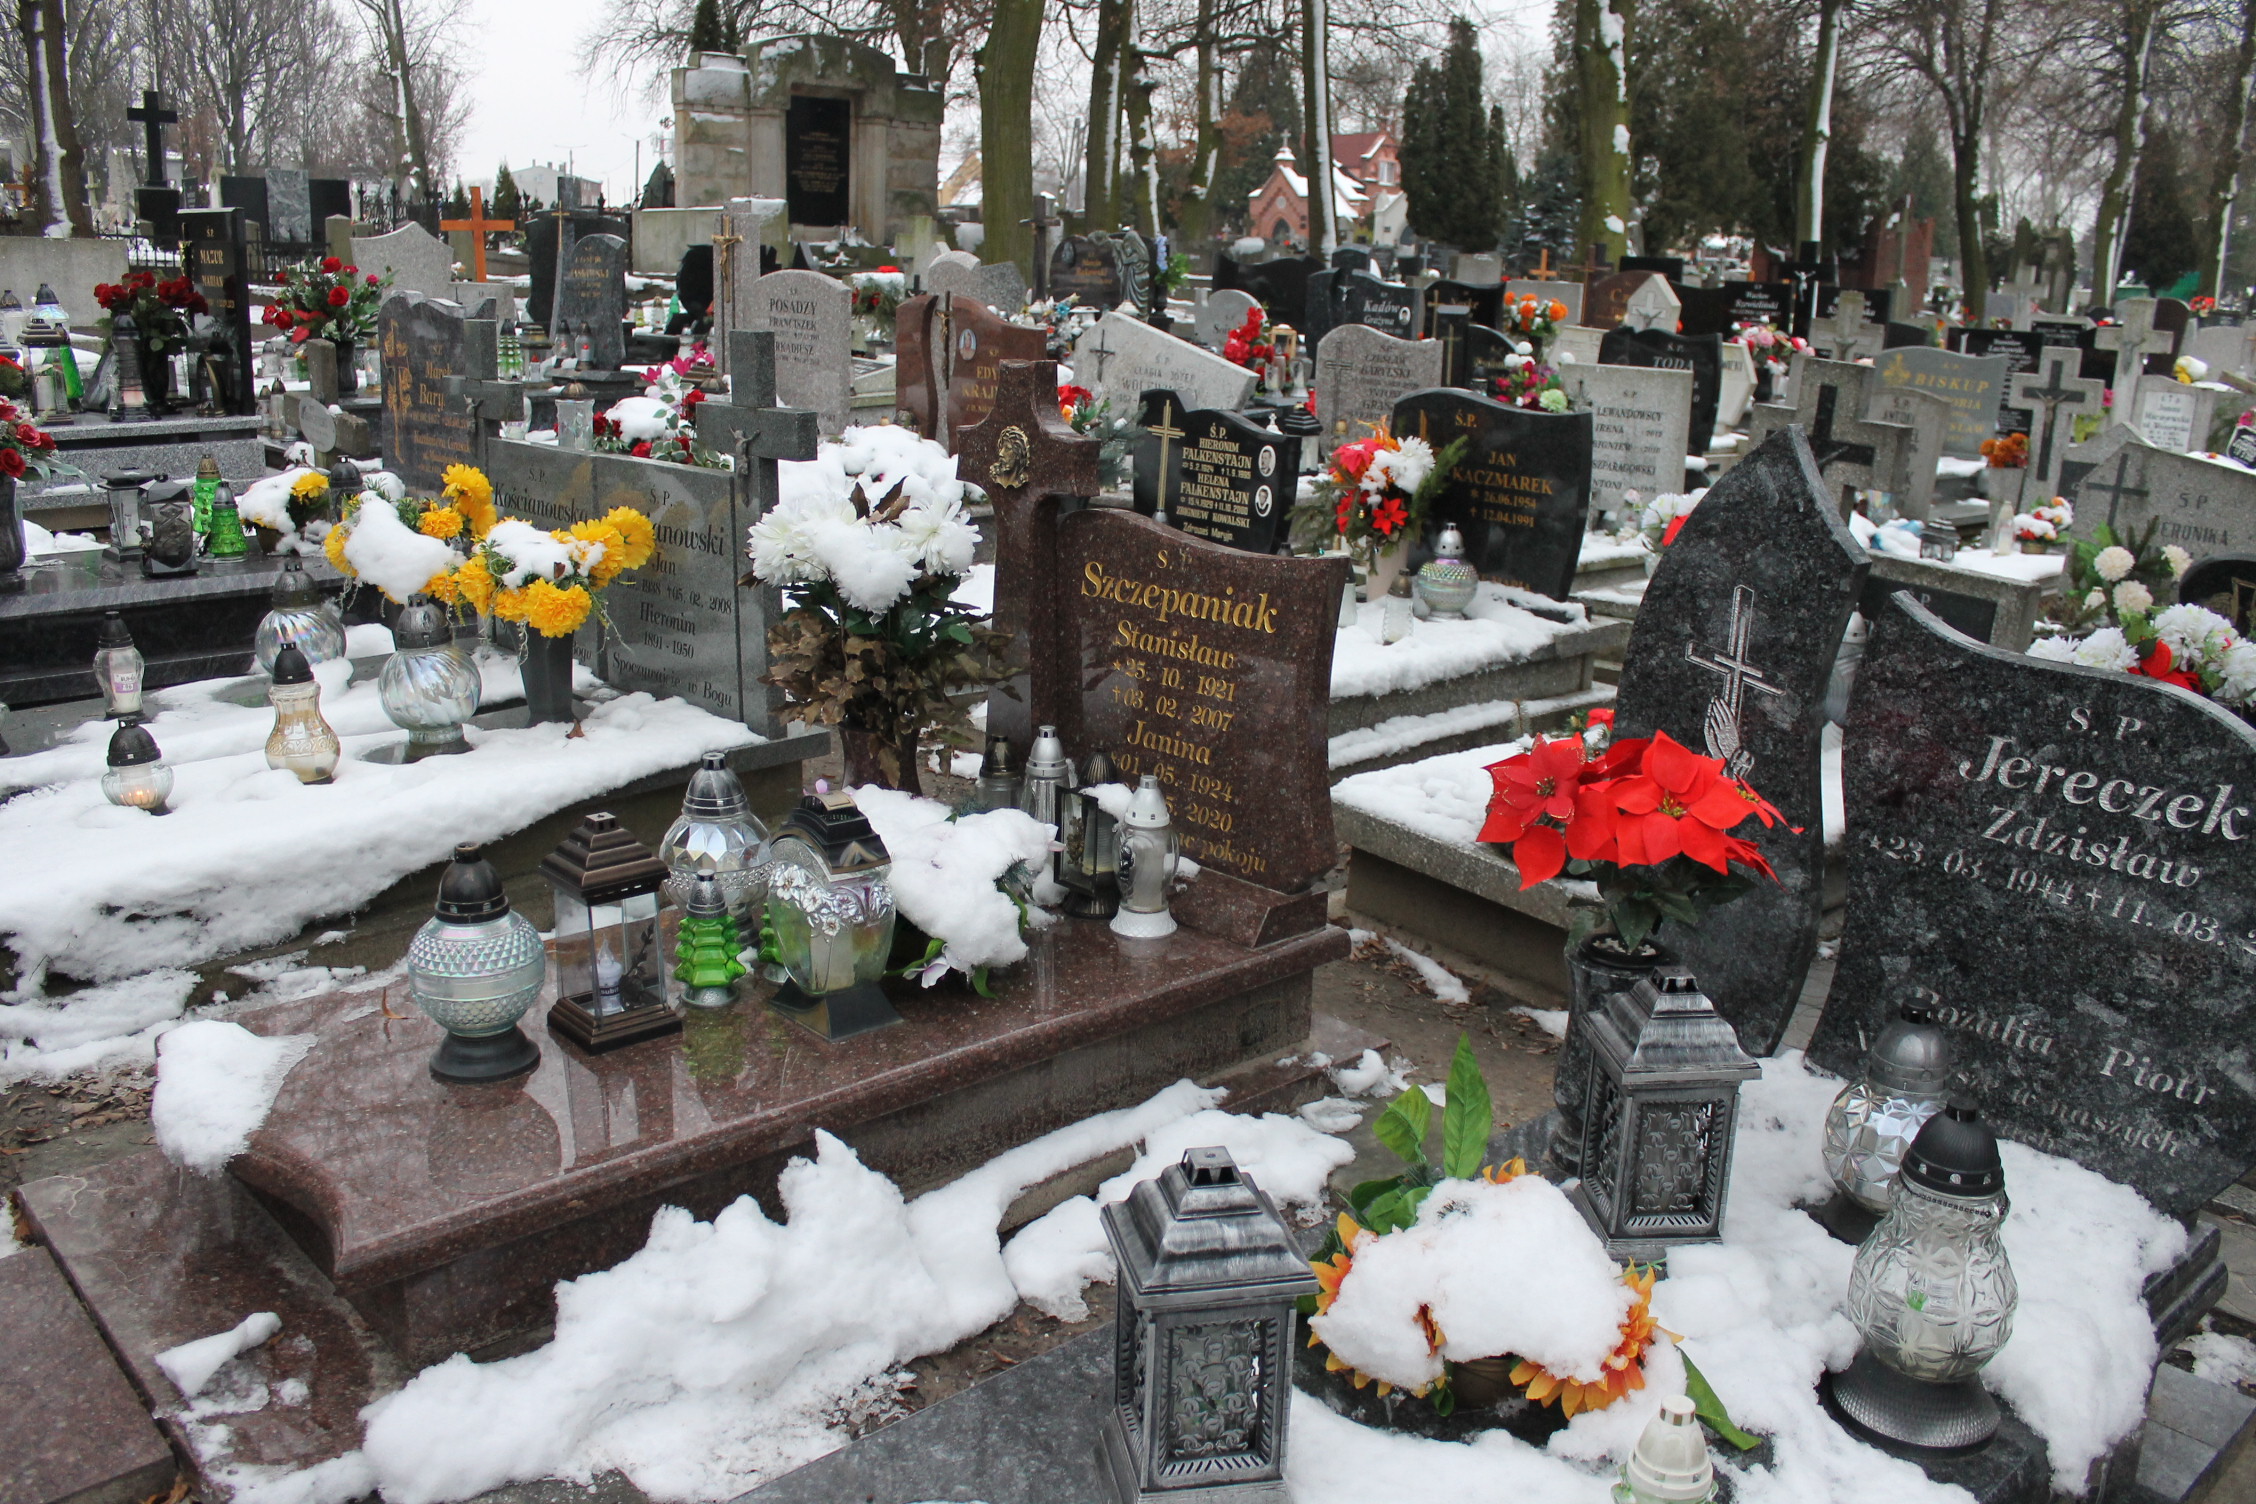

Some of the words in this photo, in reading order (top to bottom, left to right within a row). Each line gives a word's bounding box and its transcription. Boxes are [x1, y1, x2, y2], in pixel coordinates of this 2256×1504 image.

[769, 297, 818, 316] POSADZY
[775, 341, 814, 356] RKADIUSZ
[1914, 372, 1990, 393] BISKUP
[1181, 446, 1253, 470] FALKENSTAJN
[1199, 437, 1240, 453] HIERONIM
[1488, 450, 1517, 467] JAN
[1180, 481, 1250, 505] FALKENSTAJN
[1197, 472, 1230, 488] HELENA
[1452, 466, 1553, 495] KACZMAREK
[1593, 479, 1624, 490] NTONI
[493, 481, 588, 525] Kościanowska
[1176, 505, 1210, 520] ZBIGNIEW
[1211, 512, 1251, 529] KOWALSKI
[2160, 521, 2229, 547] ERONIKA
[651, 551, 677, 576] Jan
[709, 596, 732, 614] 2008
[1081, 561, 1278, 635] Szczepaniak
[639, 601, 696, 636] Hieronim
[643, 631, 663, 650] 1891
[672, 640, 694, 660] 1950
[1112, 619, 1235, 670] Stanisław
[612, 651, 681, 687] Spoczywajcie
[702, 680, 732, 708] Bogu
[1161, 667, 1185, 690] 10.
[1196, 675, 1236, 703] 1921
[1156, 695, 1182, 720] 02.
[1191, 703, 1235, 732] 2007
[1127, 719, 1212, 766] Janina
[1189, 773, 1233, 803] 1924
[1958, 734, 2250, 841] Jereczek
[1185, 801, 1233, 833] 2020
[1198, 839, 1268, 874] pokoju
[1981, 804, 2200, 888] Zdzisław
[2006, 867, 2076, 905] 1944
[2172, 910, 2225, 946] 03.
[1916, 987, 2055, 1057] ozalia
[2099, 1044, 2218, 1105] Piotr
